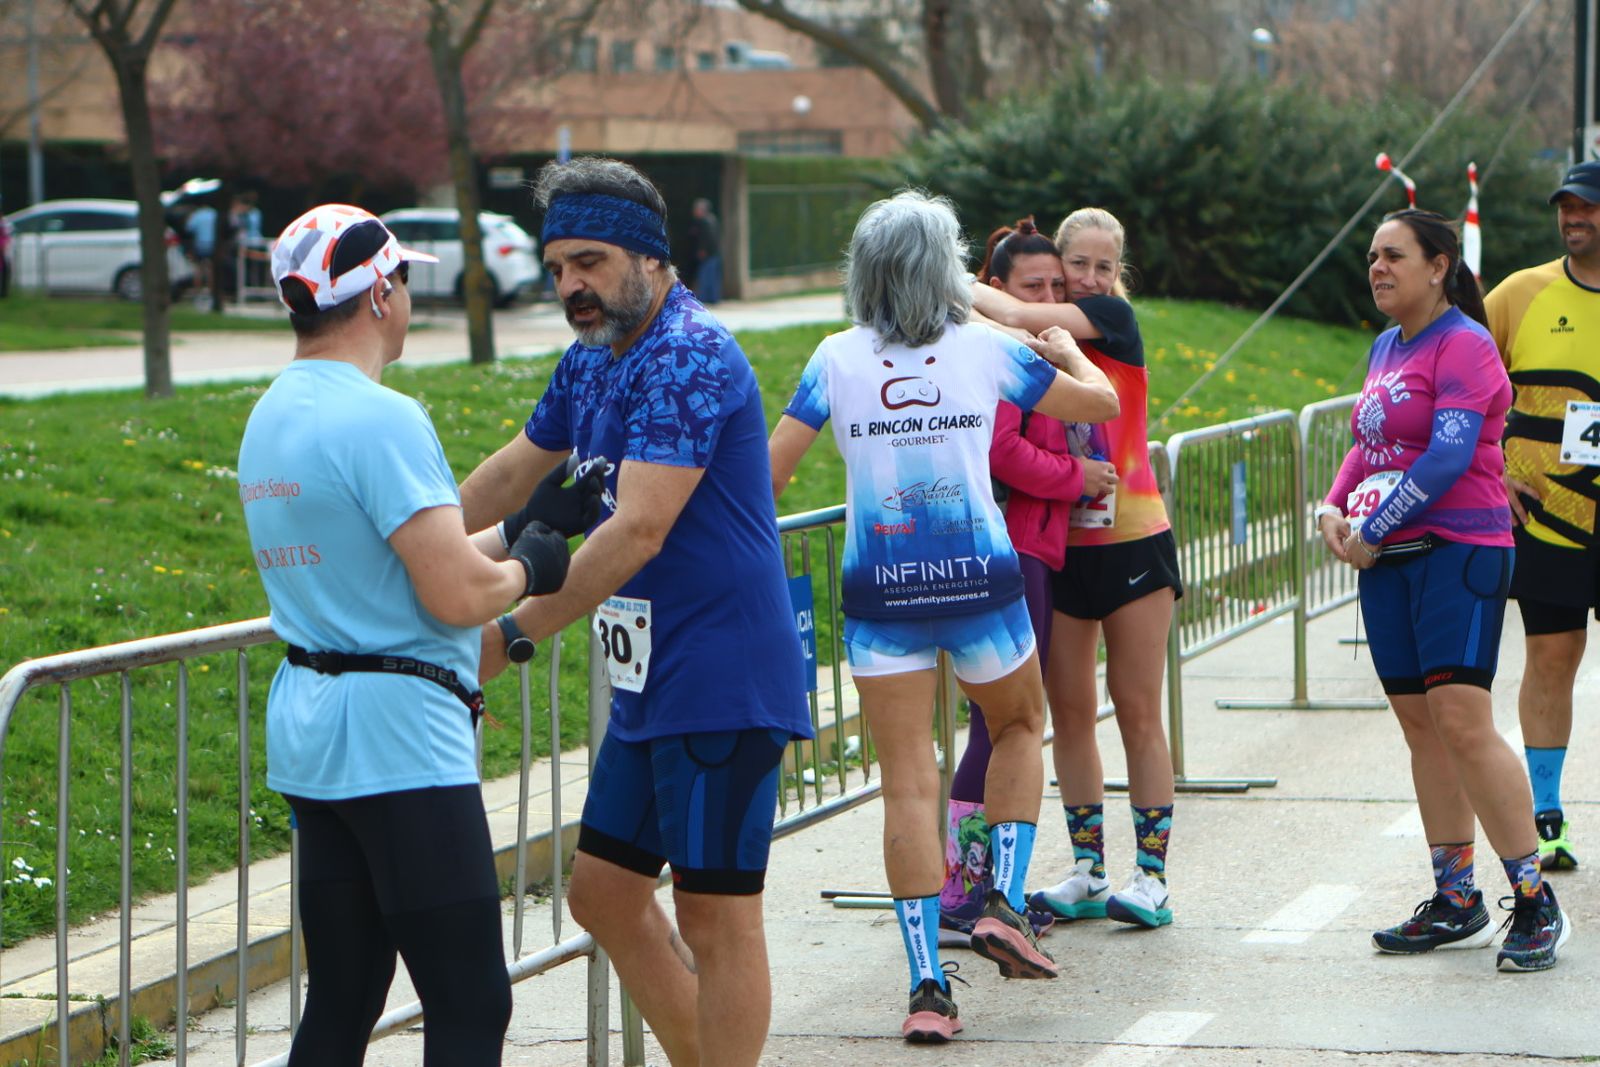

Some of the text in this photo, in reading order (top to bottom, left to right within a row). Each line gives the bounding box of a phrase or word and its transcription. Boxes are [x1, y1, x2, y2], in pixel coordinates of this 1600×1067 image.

[850, 414, 982, 438] EL RINCÓN CHARRO
[1350, 489, 1381, 519] 29
[1369, 477, 1429, 538] Apaches
[875, 554, 991, 585] INFINITY
[885, 590, 990, 607] www.infinityasesores.es
